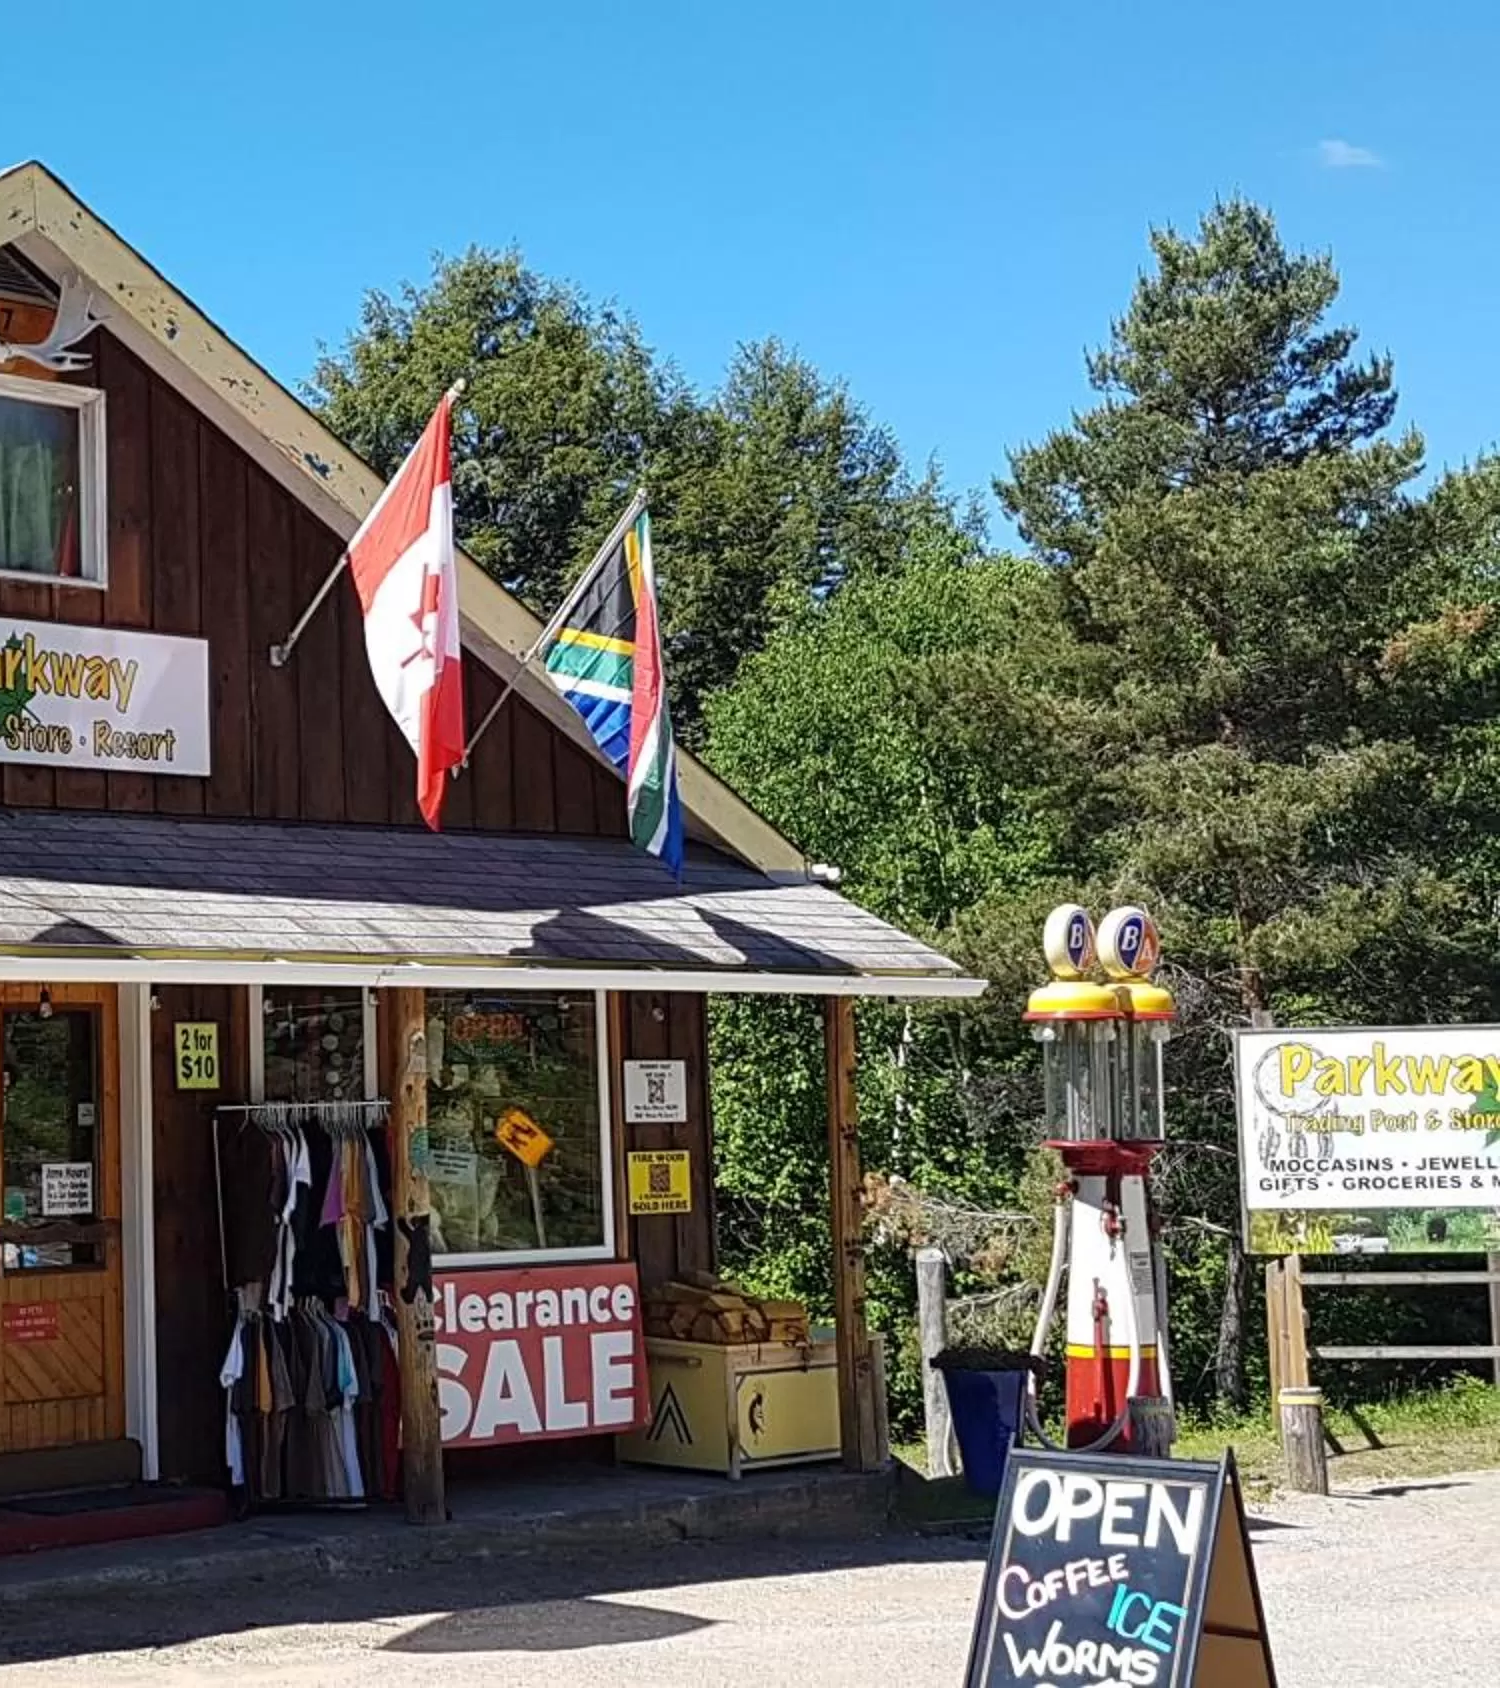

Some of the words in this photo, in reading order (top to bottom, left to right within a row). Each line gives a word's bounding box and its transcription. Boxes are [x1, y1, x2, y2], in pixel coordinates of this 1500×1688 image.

[4, 714, 73, 754] Store
[93, 721, 176, 761] Resort
[1070, 923, 1083, 949] B
[1122, 925, 1139, 951] B
[181, 1028, 191, 1051] 2
[194, 1028, 213, 1051] for
[181, 1055, 215, 1082] $10
[1284, 1109, 1365, 1135] Trading
[1370, 1109, 1418, 1132] Post
[1424, 1110, 1442, 1131] &
[1270, 1158, 1394, 1173] MOCCASINS
[1415, 1155, 1500, 1171] JEWELL
[1259, 1176, 1319, 1191] GIFTS
[1342, 1174, 1462, 1190] GROCERIES
[1470, 1174, 1483, 1188] &
[435, 1330, 635, 1443] SALE
[1011, 1468, 1205, 1556] OPEN
[996, 1553, 1130, 1620] COFFEE
[1106, 1583, 1188, 1653] ICE
[1003, 1620, 1160, 1686] WORMS
